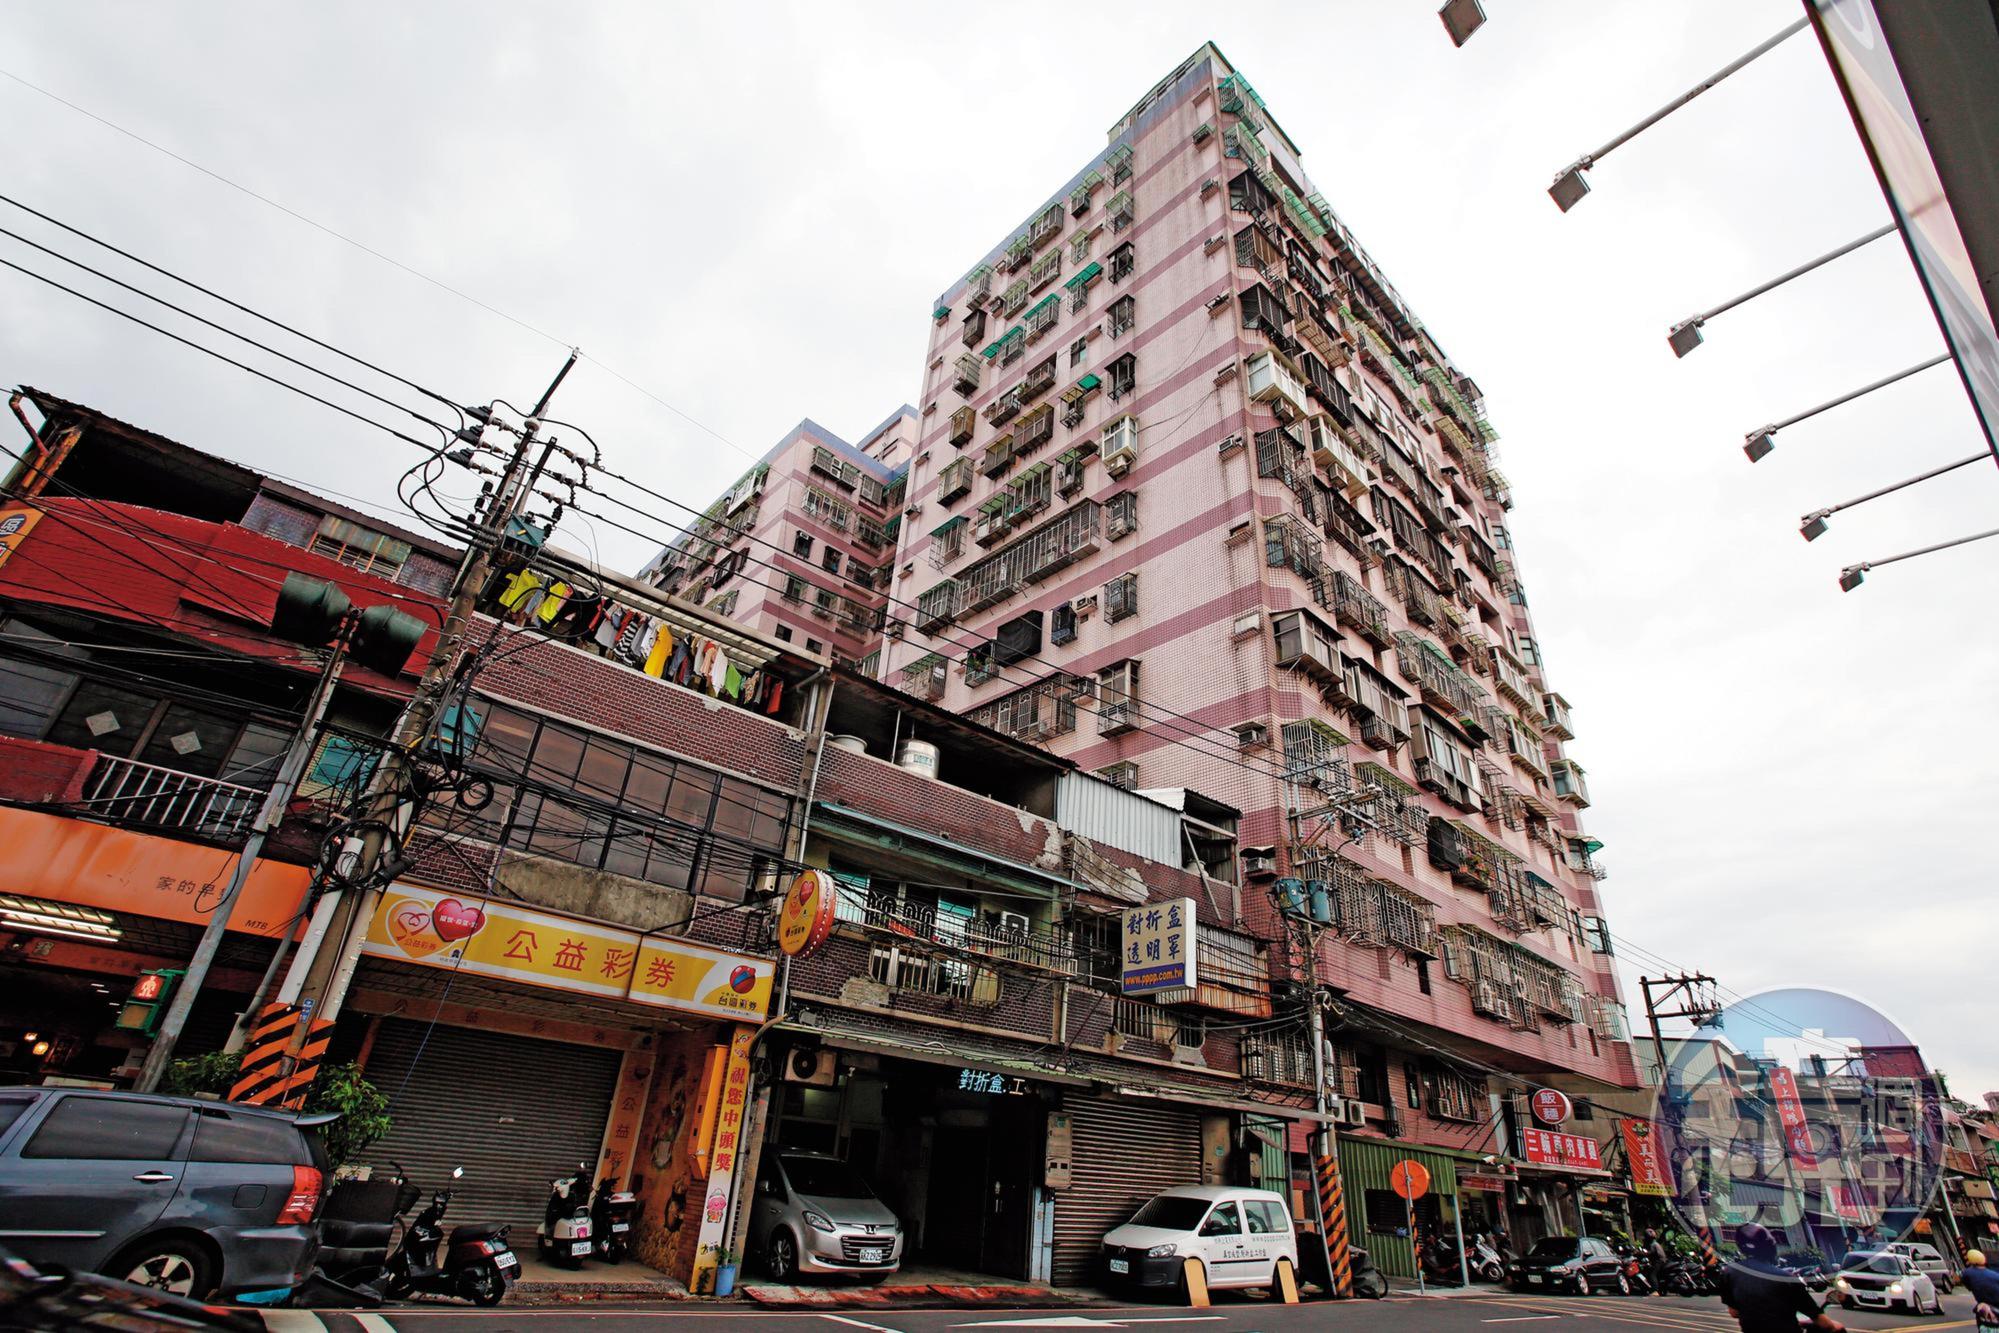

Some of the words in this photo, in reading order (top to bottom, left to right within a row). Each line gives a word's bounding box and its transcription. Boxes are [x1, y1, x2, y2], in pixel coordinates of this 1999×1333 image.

[1127, 904, 1182, 935] 對折盒
[504, 929, 677, 989] 公益彩券
[1127, 934, 1181, 965] 透明罩
[715, 1066, 746, 1172] 祝您中頭獎
